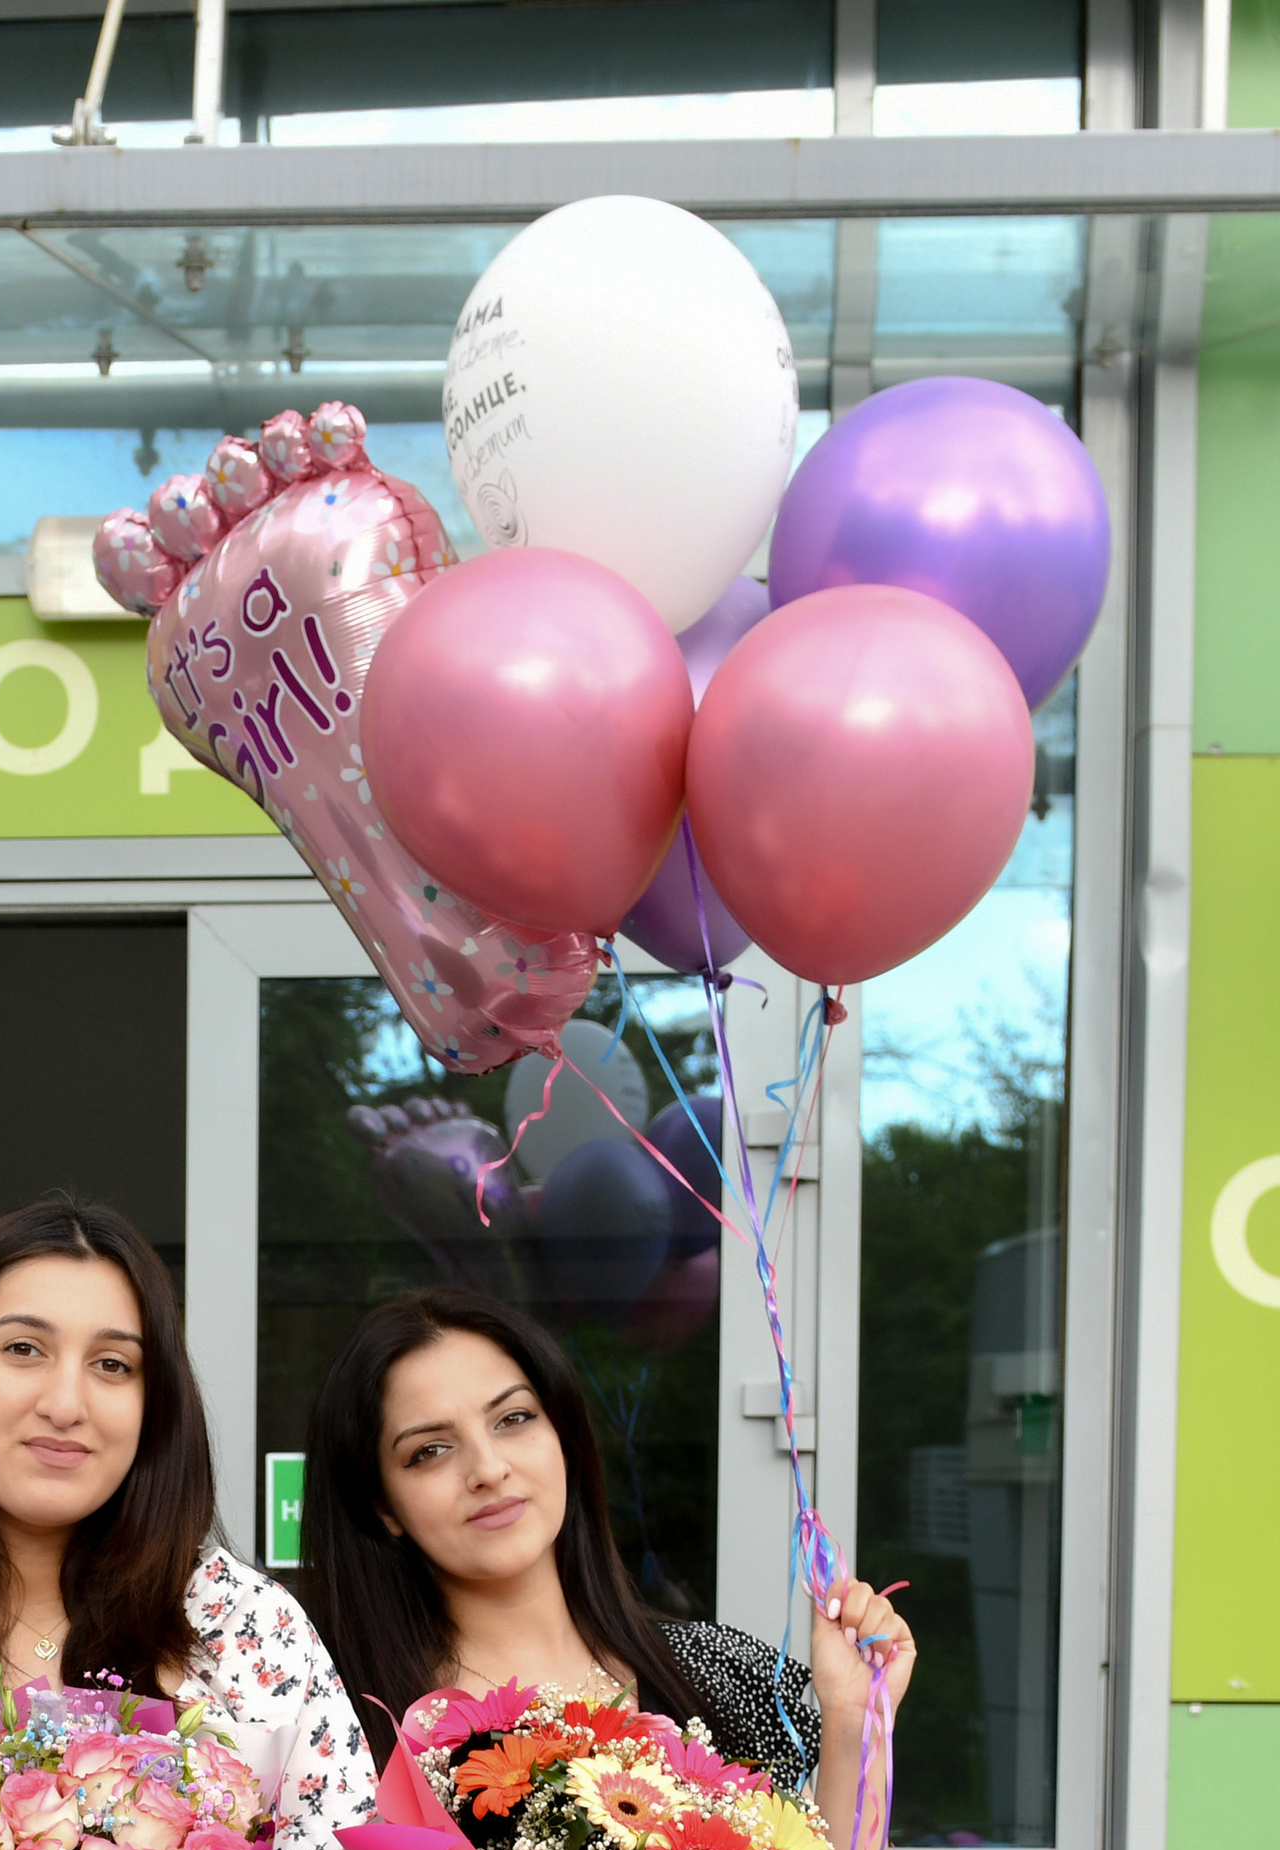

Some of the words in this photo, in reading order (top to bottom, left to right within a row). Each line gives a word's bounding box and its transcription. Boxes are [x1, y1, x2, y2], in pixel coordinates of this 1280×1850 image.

[448, 372, 527, 451] СОЛНЦЕ,
[163, 617, 236, 732] It's
[240, 565, 292, 636] a
[207, 613, 355, 810] Girl!
